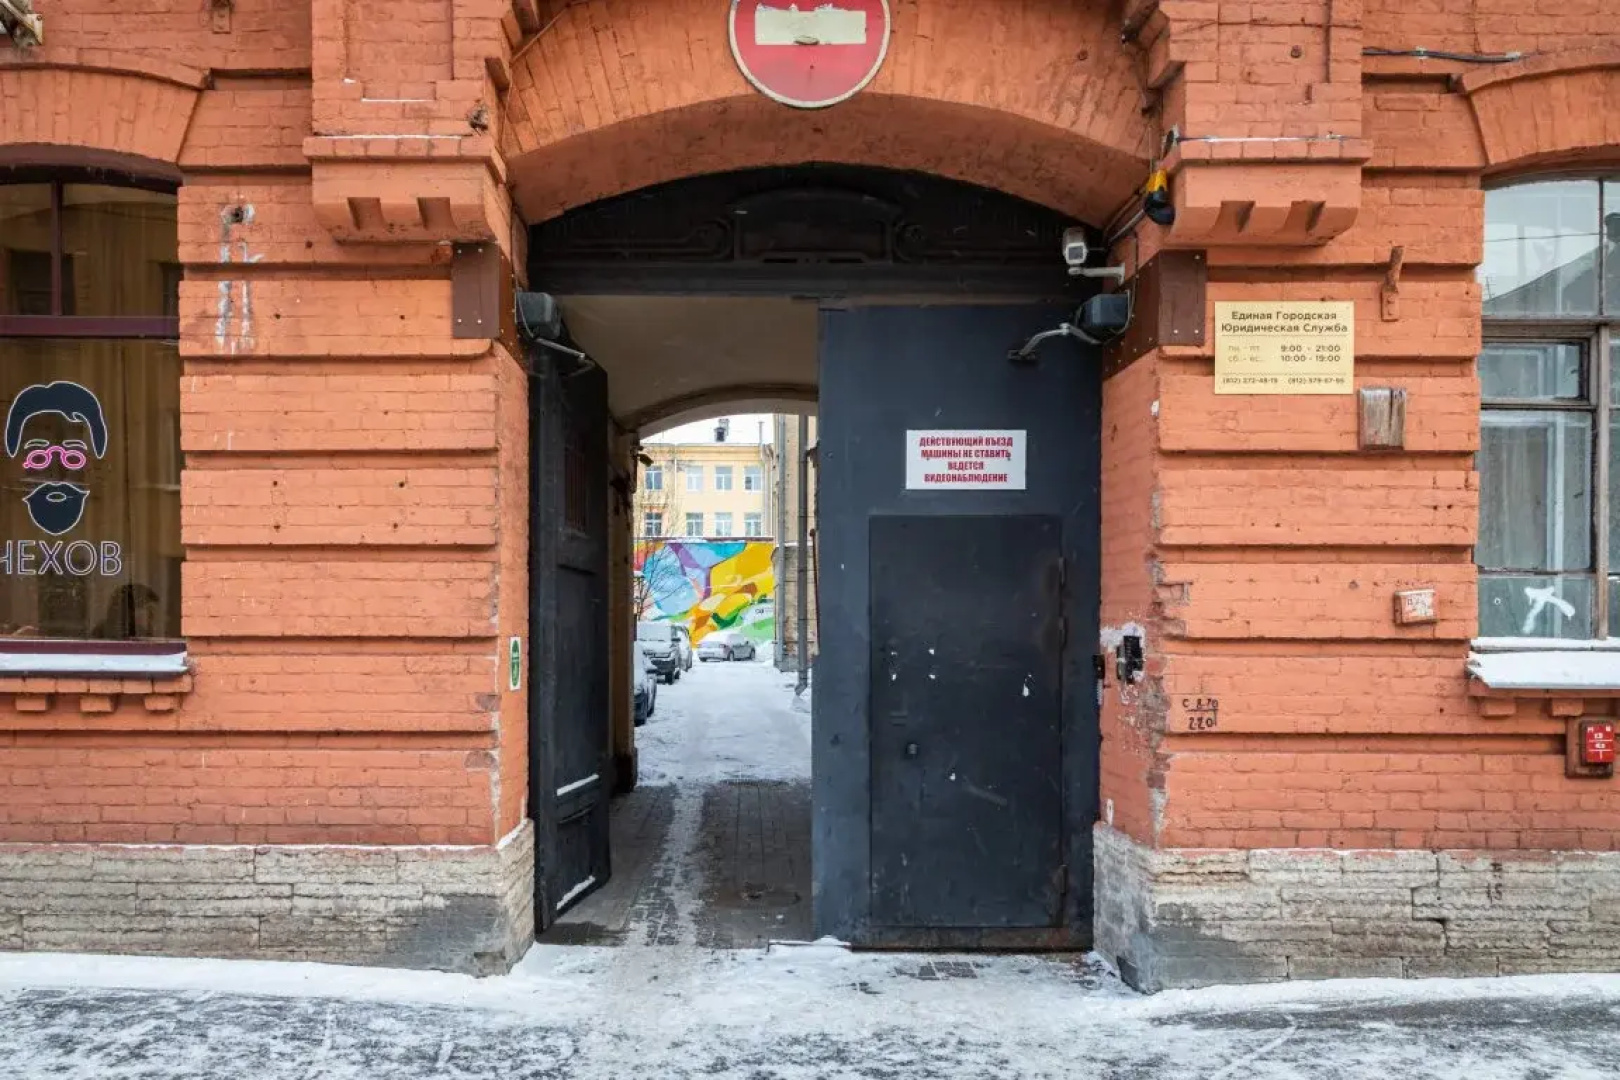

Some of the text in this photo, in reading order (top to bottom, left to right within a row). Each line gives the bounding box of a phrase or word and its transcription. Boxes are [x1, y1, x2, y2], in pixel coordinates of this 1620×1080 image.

[1231, 311, 1337, 321] Единая Городская
[1221, 323, 1348, 334] Юридическая Служба
[919, 436, 1013, 447] ДЕЙСТВУЮЩИЙ ВЪЕЗД
[921, 449, 1011, 458] МАШИНЫ НЕ СТАВИТЬ
[948, 461, 984, 471] ВЕДЕТСЯ
[924, 473, 1008, 482] ВИДЕОНАБЛЮДЕНИЕ
